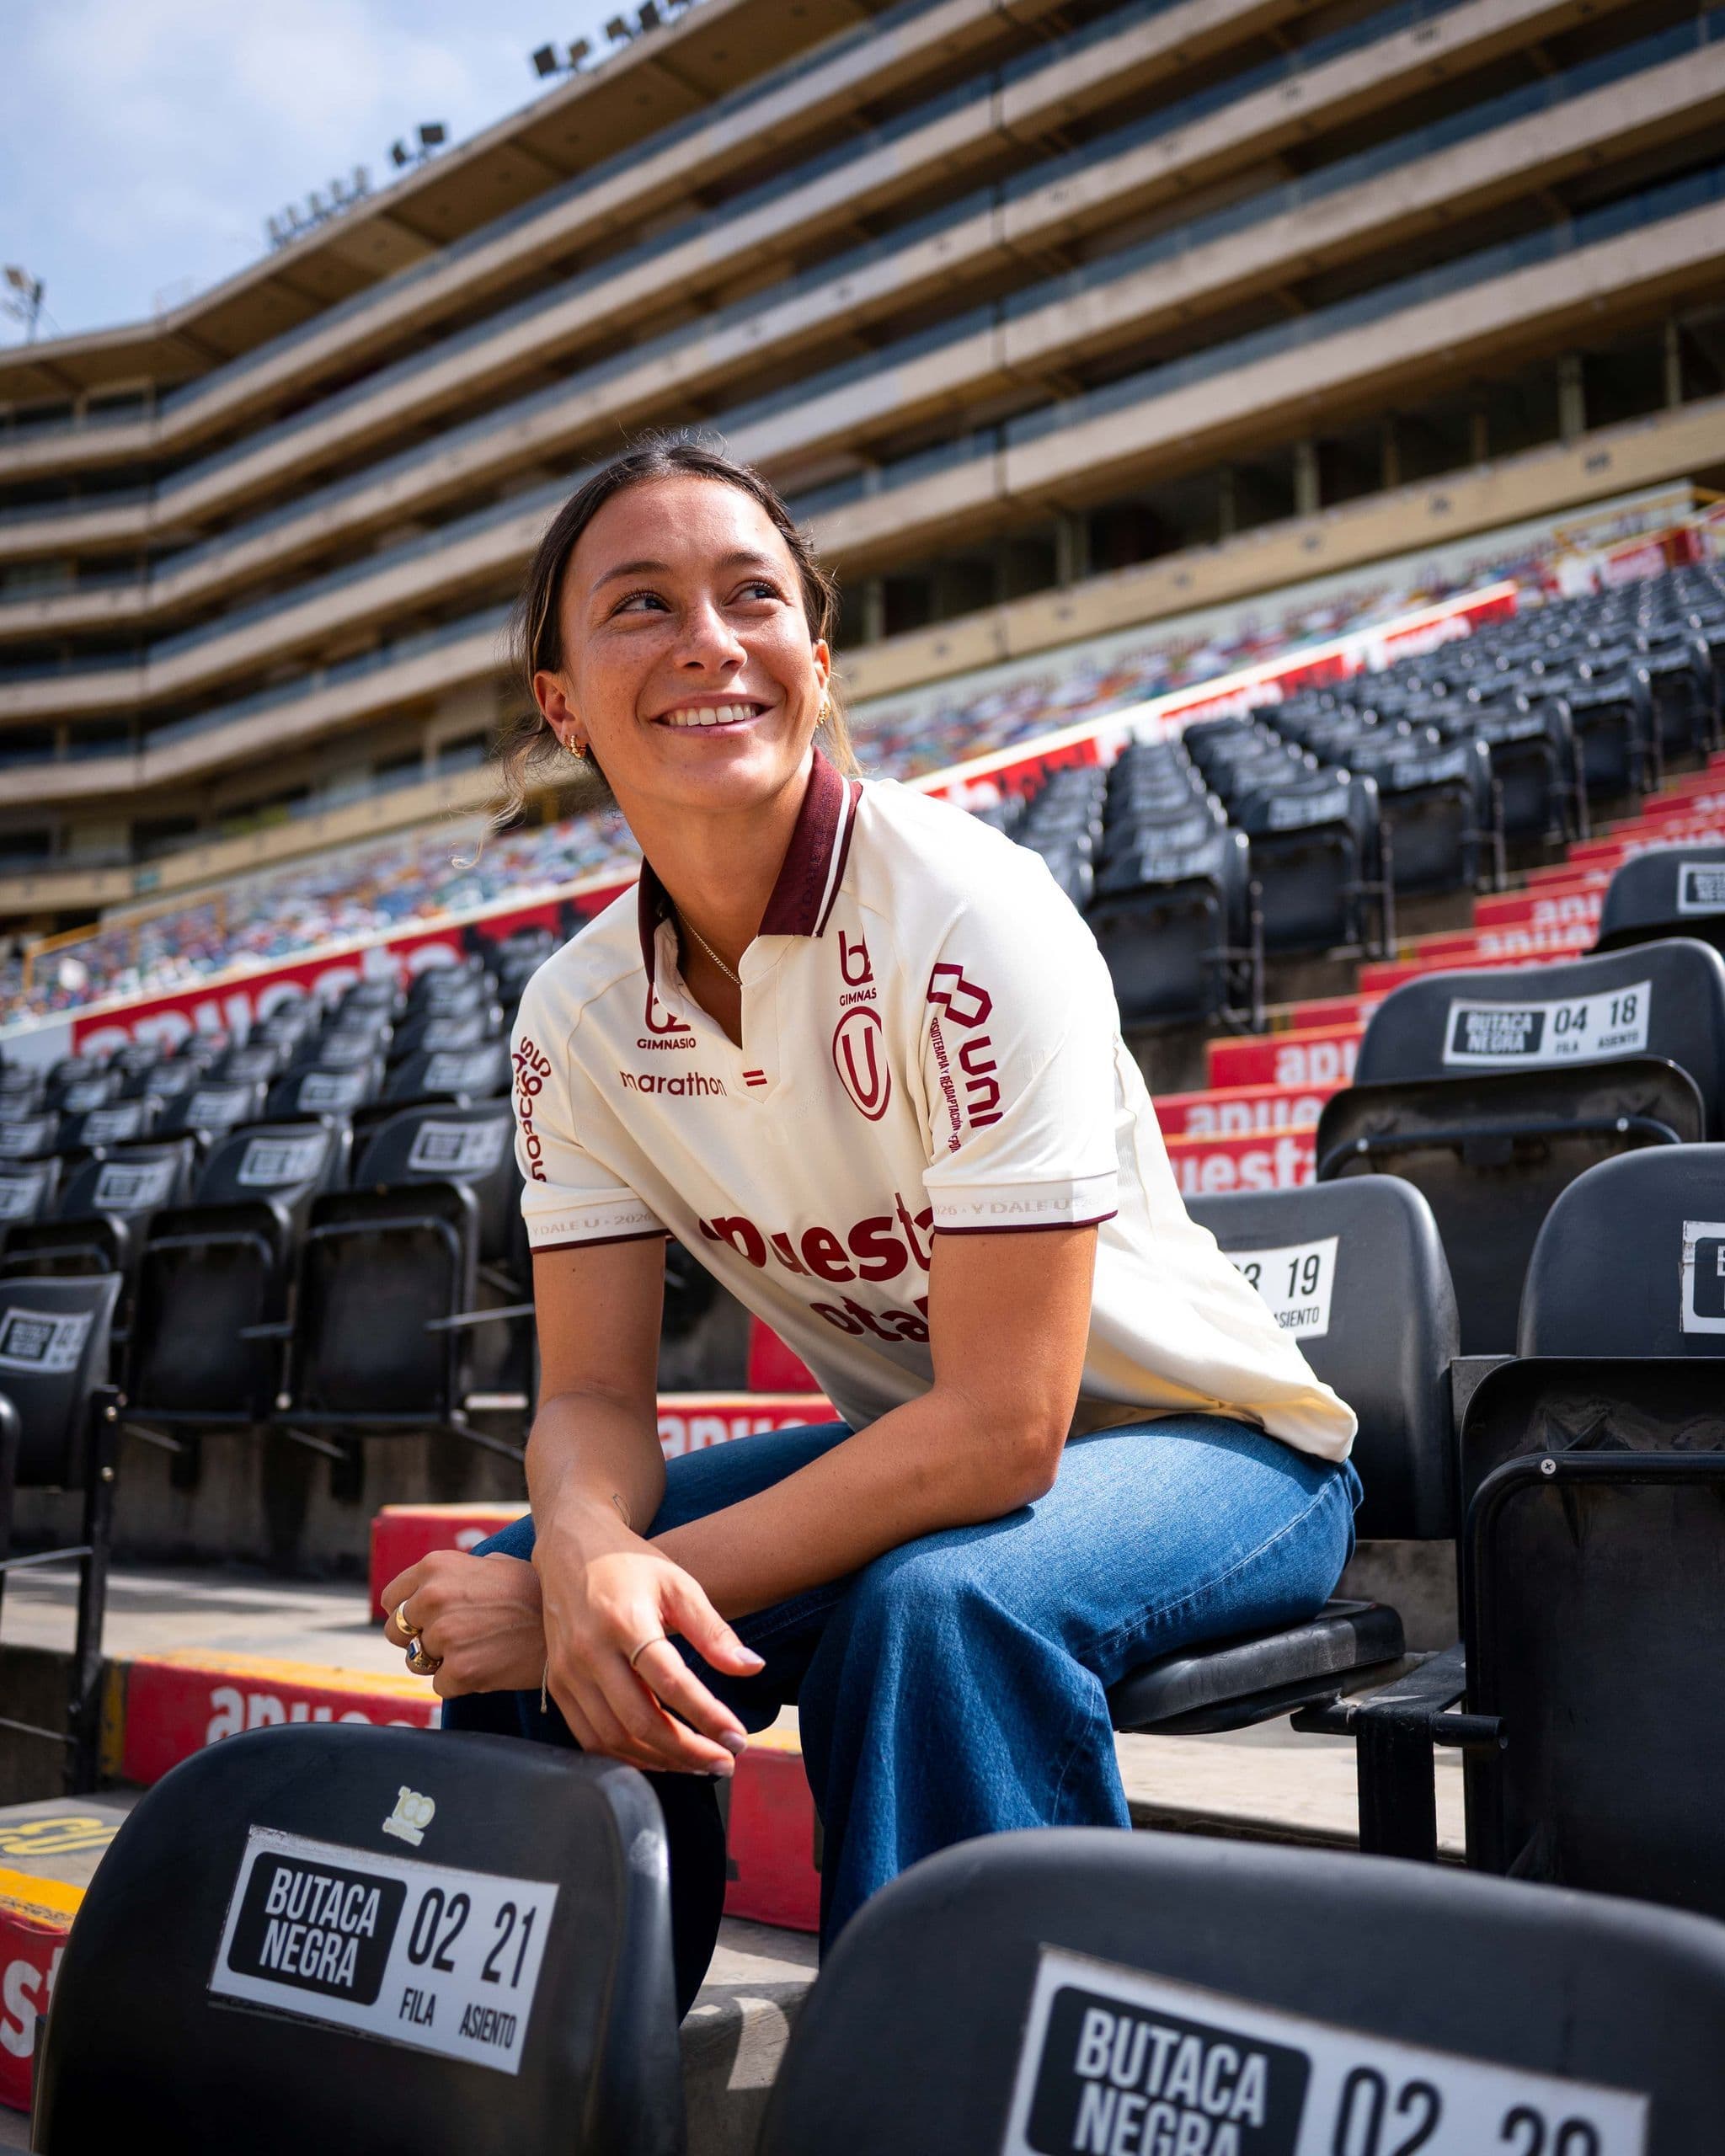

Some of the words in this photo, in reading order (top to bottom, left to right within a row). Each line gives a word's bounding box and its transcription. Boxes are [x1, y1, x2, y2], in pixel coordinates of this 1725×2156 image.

[839, 987, 877, 1006] GIMNAS
[1554, 1006, 1588, 1035] 04
[1610, 994, 1637, 1027] 18
[637, 1038, 697, 1050] GIMNASIO
[841, 1026, 879, 1107] U
[620, 1071, 727, 1096] marathon
[940, 1075, 963, 1131] READAPTACIÓN
[1288, 1254, 1320, 1298] 19
[265, 1867, 382, 1937] BUTACA
[259, 1919, 360, 1988] NEGRA
[407, 1886, 472, 1973] 02
[480, 1901, 537, 1988] 21
[398, 1988, 437, 2027] FILA
[459, 2003, 518, 2049] ASIENTO
[1074, 2007, 1268, 2129] BUTACA
